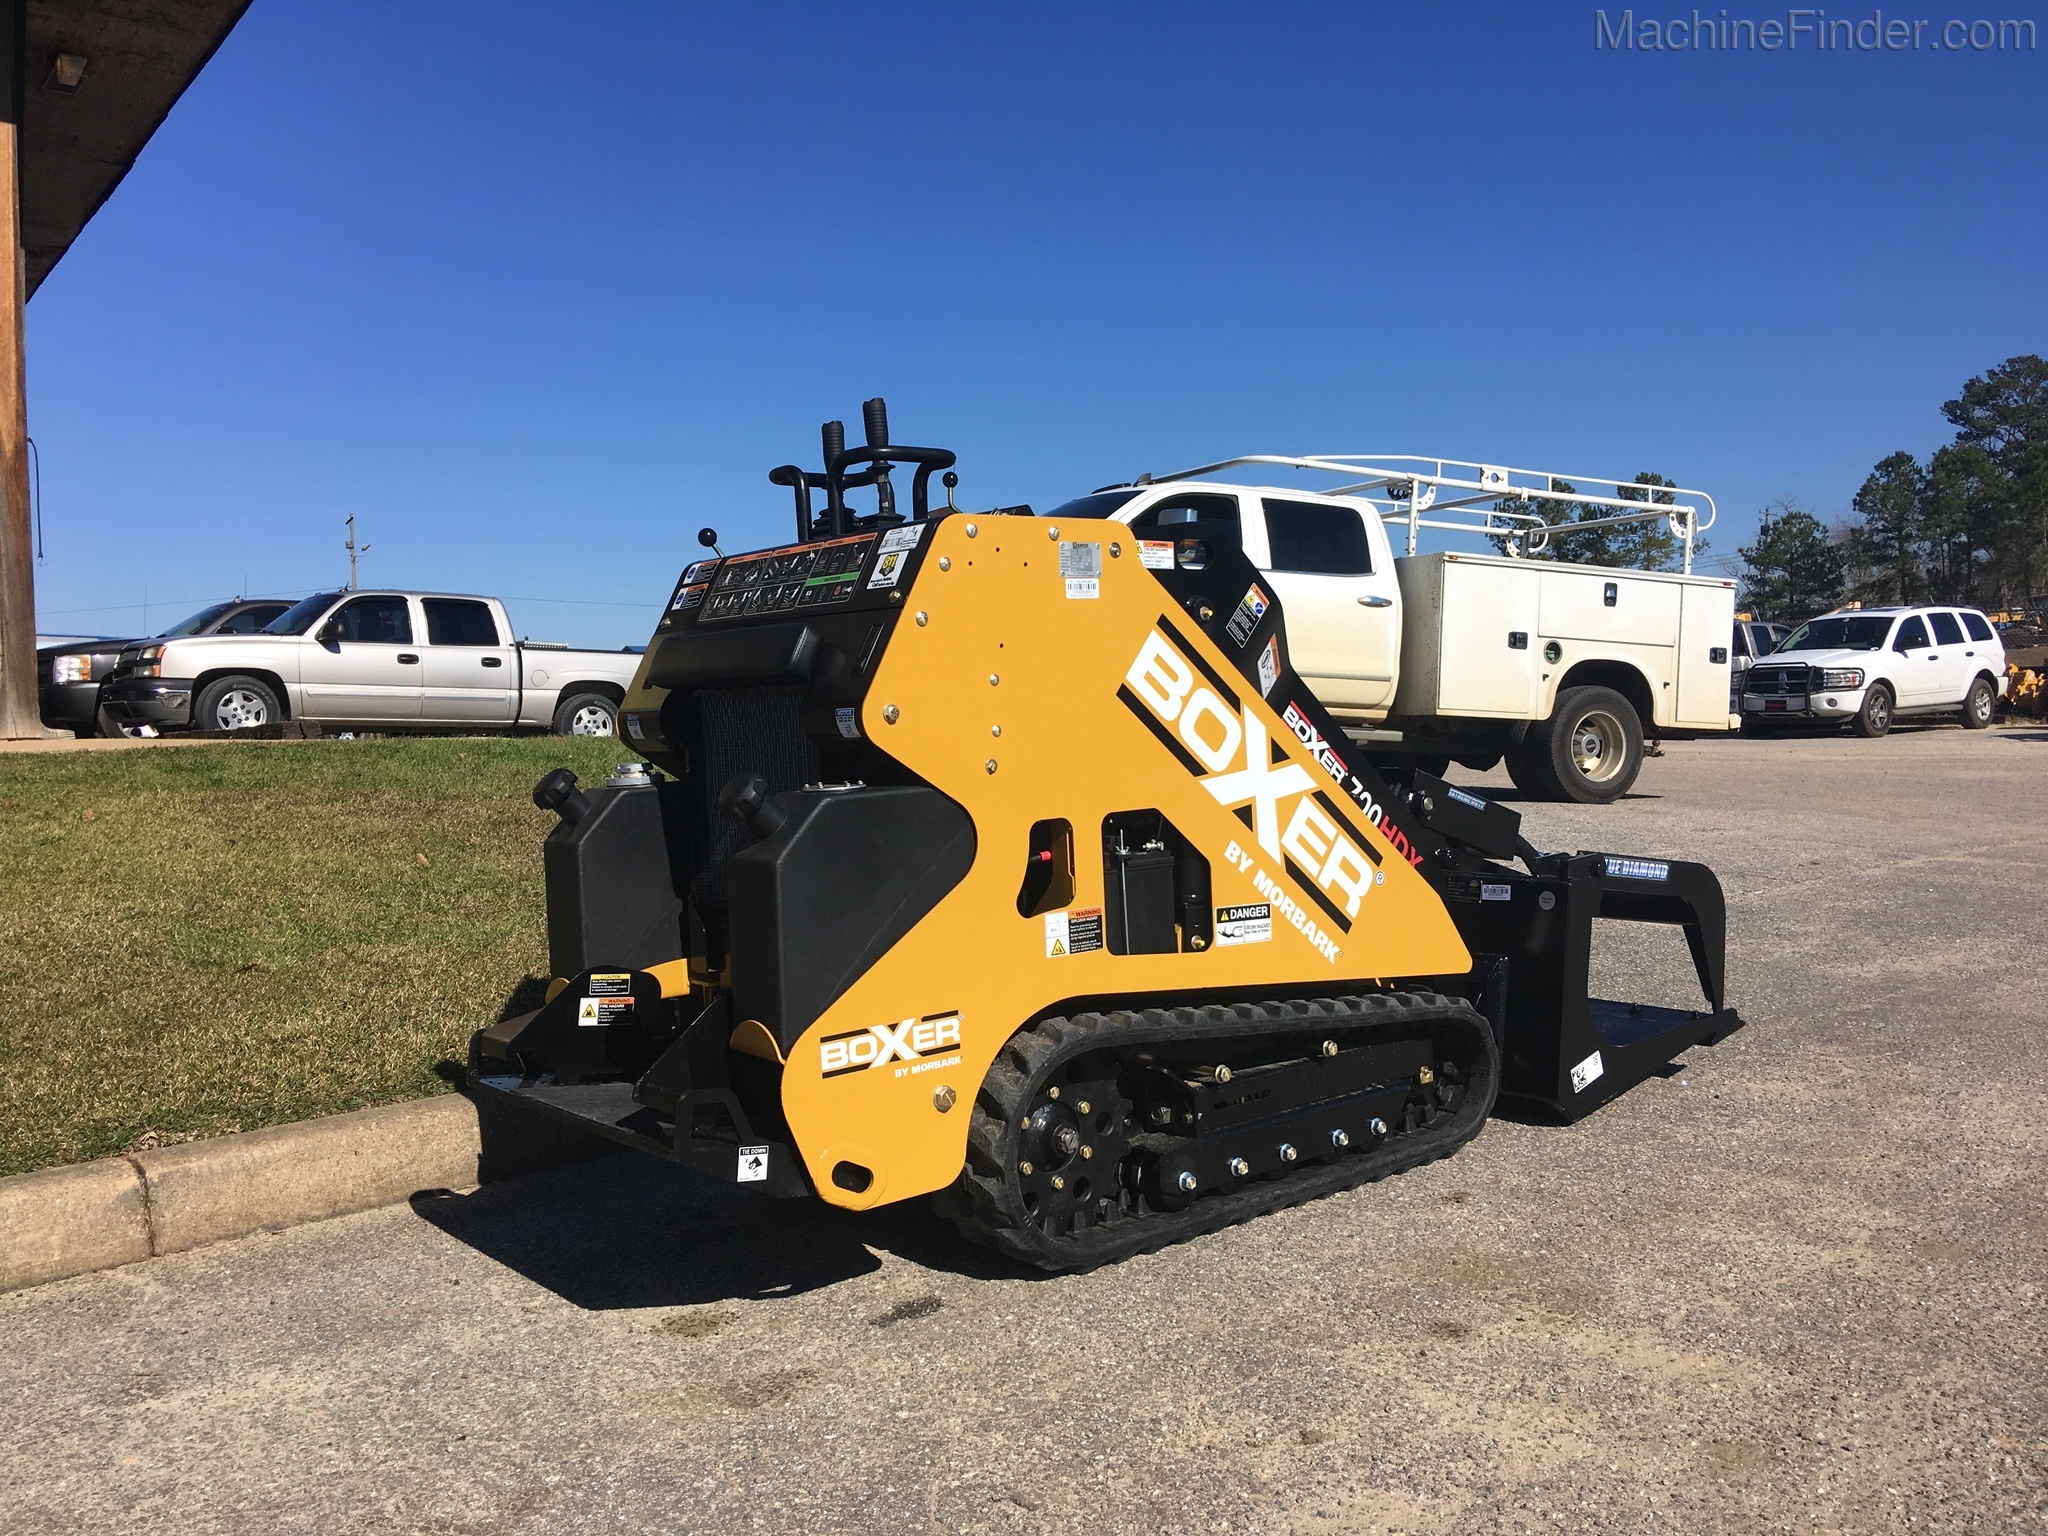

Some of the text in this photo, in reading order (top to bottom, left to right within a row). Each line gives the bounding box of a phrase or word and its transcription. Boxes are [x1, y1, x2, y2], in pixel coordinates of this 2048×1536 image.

[882, 553, 899, 569] 811
[1282, 704, 1347, 785] BOXER
[1125, 629, 1374, 919] BOXER
[1622, 860, 1669, 879] DIAMOND
[1075, 908, 1102, 917] WARNING
[1223, 839, 1341, 965] BY MORBARK
[1230, 905, 1268, 920] DANGER
[820, 1017, 961, 1071] BOXER
[894, 1055, 962, 1079] BY MORBARK
